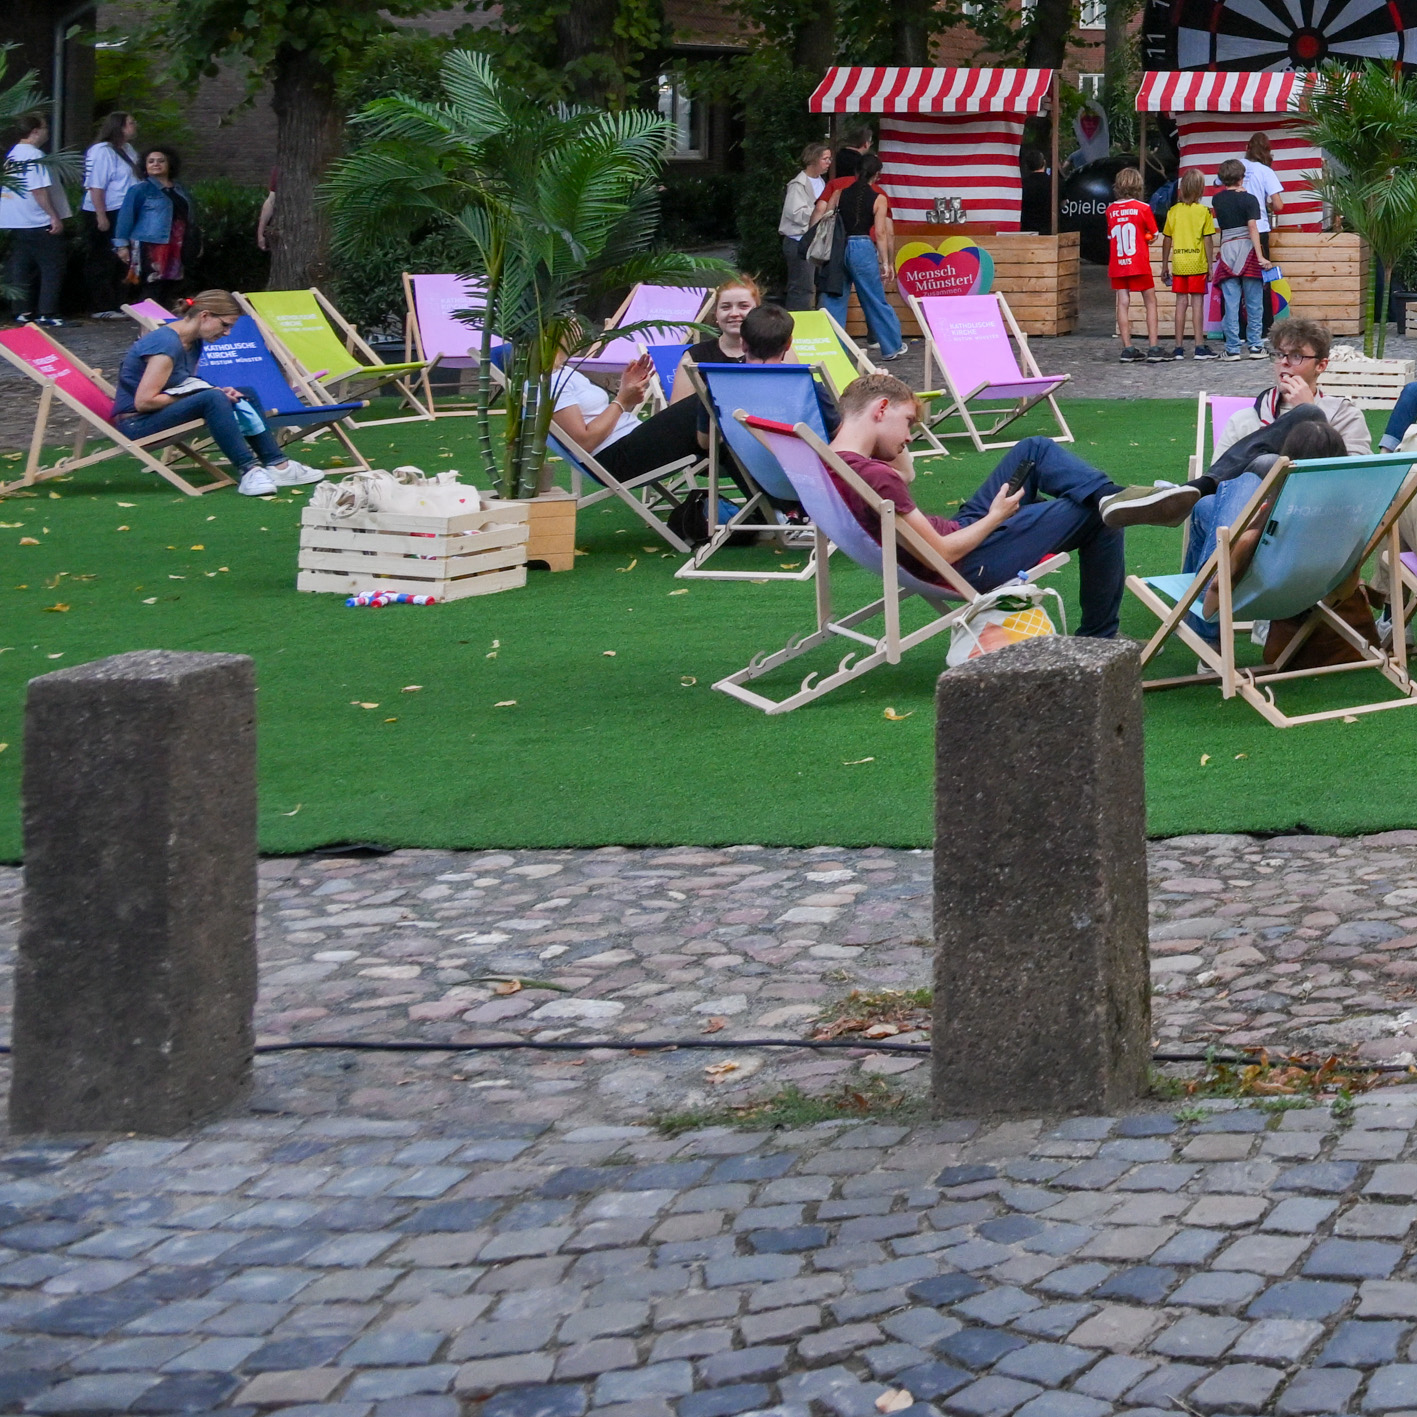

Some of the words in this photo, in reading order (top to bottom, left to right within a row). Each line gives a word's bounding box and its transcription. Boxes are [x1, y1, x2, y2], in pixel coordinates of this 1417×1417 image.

[1146, 34, 1166, 58] 11
[1061, 199, 1112, 217] Spiele
[1111, 222, 1136, 257] 10
[906, 265, 956, 282] Mensch
[915, 274, 973, 291] Münster!
[203, 341, 257, 352] KATHOLISCHE
[206, 350, 239, 359] KIRCHE
